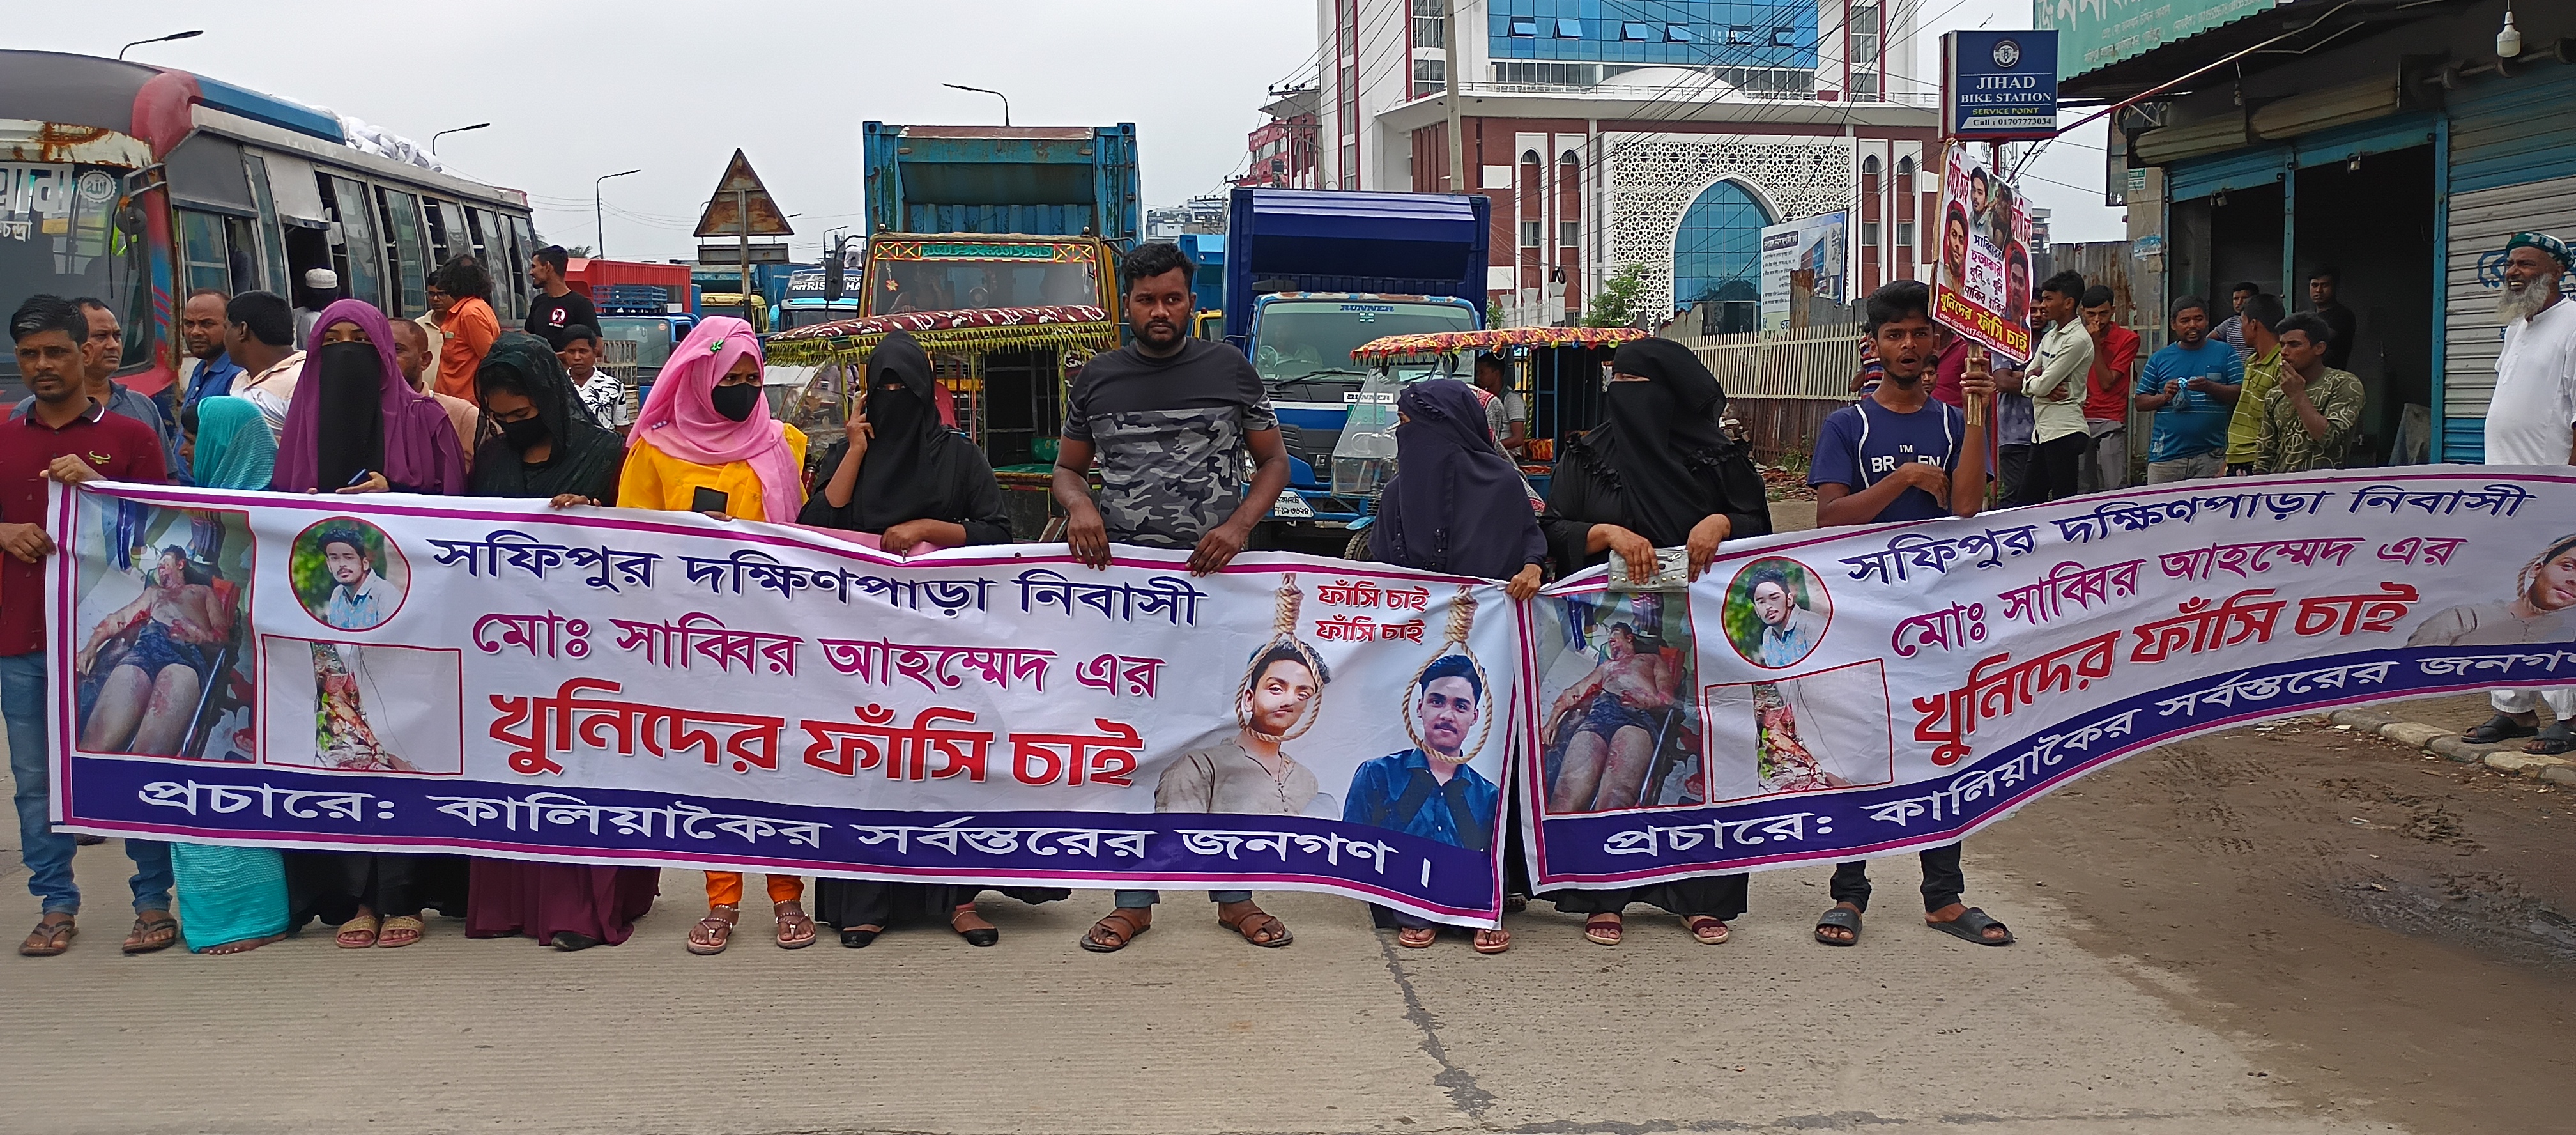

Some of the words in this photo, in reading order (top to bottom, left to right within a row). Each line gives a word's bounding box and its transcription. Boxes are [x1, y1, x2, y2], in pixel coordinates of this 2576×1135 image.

[1961, 94, 1992, 102] BIKE
[1996, 93, 2051, 102] STATION
[1977, 77, 2035, 89] JIHAD
[1940, 292, 1972, 320] খুনিদের
[1977, 311, 2002, 341] ফাঁসি
[2007, 328, 2028, 352] চাই
[1871, 455, 1940, 473] BREN
[1899, 444, 1913, 453] I'M
[425, 530, 663, 594] সফিপুর
[678, 550, 998, 618] দক্ষিণপাড়া
[1011, 568, 1209, 627] নিবাসী
[1838, 525, 2039, 585] সফিপুর
[2050, 490, 2334, 544] দক্ষিণপাড়া
[2349, 484, 2538, 518] নিবাসী
[1315, 614, 1376, 642] ফাঁসি
[1381, 619, 1425, 644] চাই
[1317, 579, 1381, 608] ফাঁসি
[1386, 585, 1430, 612] চাই
[1891, 600, 1986, 658] মোঃ
[1998, 560, 2146, 626] সাব্বির
[2158, 537, 2366, 581] আহম্মেদ
[2377, 536, 2469, 567] এর
[473, 609, 591, 660] মোঃ
[610, 612, 805, 676] সাব্বির
[822, 636, 1059, 694] আহম্মেদ
[1076, 653, 1167, 699] এর
[1912, 629, 2122, 766] খুনিদের
[2130, 587, 2287, 663] ফাঁসি
[2294, 582, 2419, 637] চাই
[489, 677, 786, 775] খুনিদের
[799, 703, 995, 782] ফাঁসি
[1008, 718, 1144, 787] চাই
[1604, 812, 1834, 858] প্রচারে:
[1859, 708, 2142, 826] কালিয়াকৈর
[2154, 661, 2400, 718] সর্বস্তরের
[2416, 649, 2576, 676] জনগ
[138, 779, 394, 822] প্রচারে:
[425, 792, 833, 849] কালিয়াকৈর
[850, 815, 1157, 859] সর্বস্তরের
[1173, 828, 1398, 874] জনগণ
